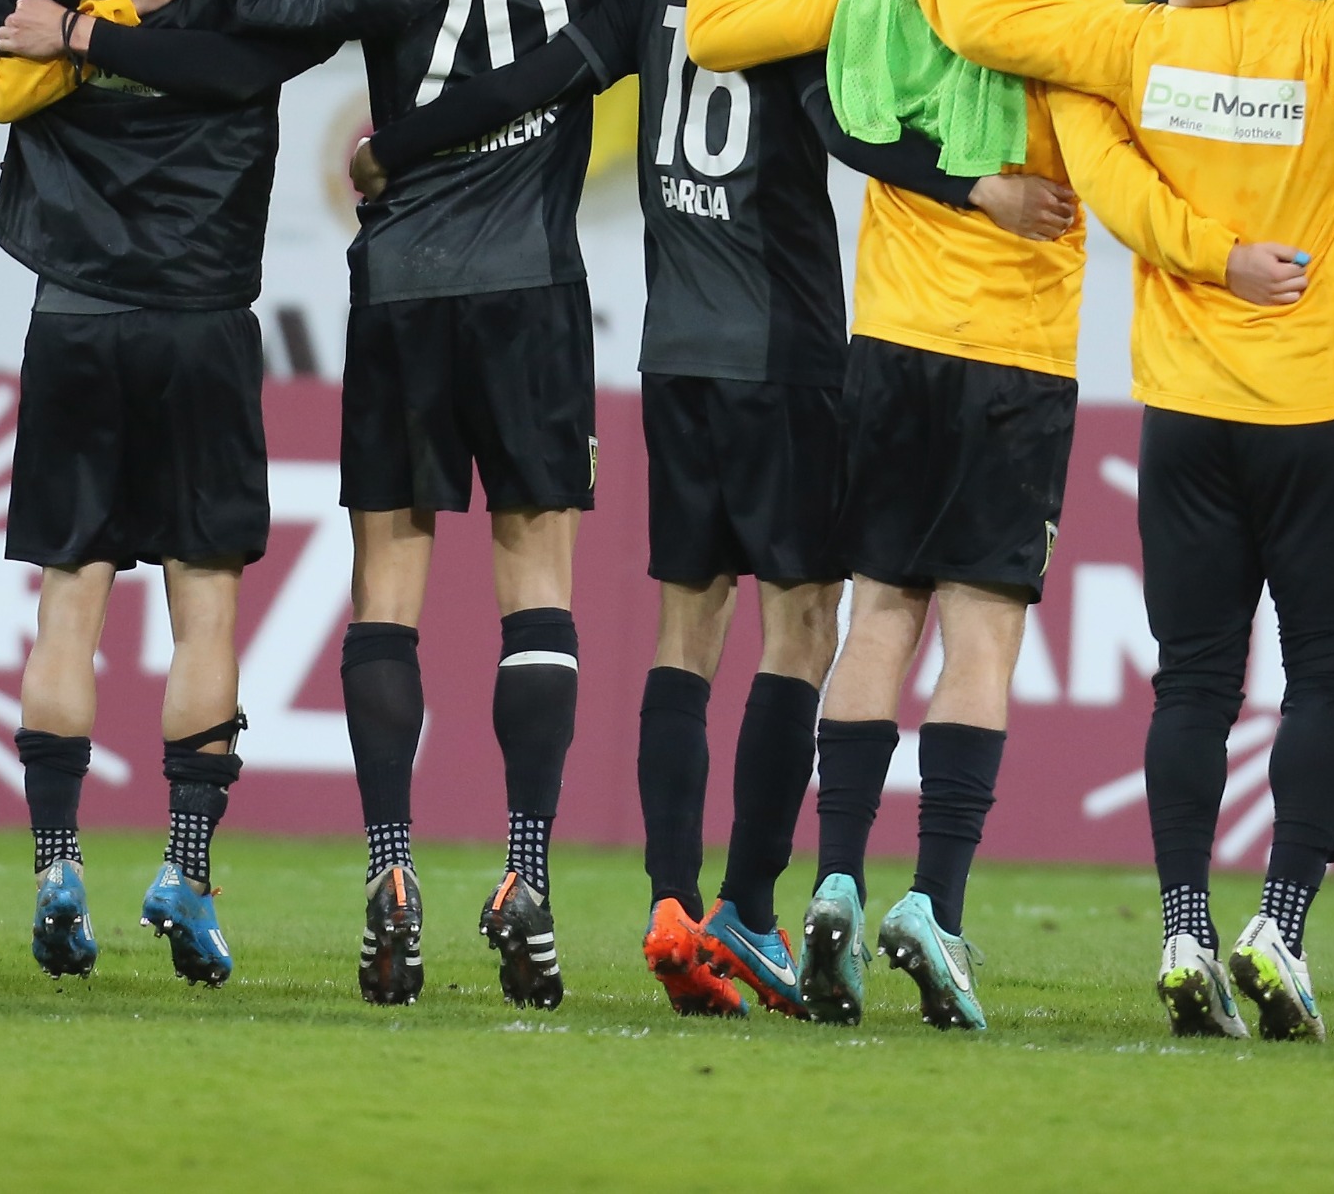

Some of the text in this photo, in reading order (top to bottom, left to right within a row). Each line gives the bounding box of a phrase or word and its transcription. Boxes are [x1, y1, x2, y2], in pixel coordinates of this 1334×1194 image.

[1147, 82, 1305, 120] DocMorris
[1169, 115, 1204, 132] Meine
[1233, 126, 1283, 140] Apotheke
